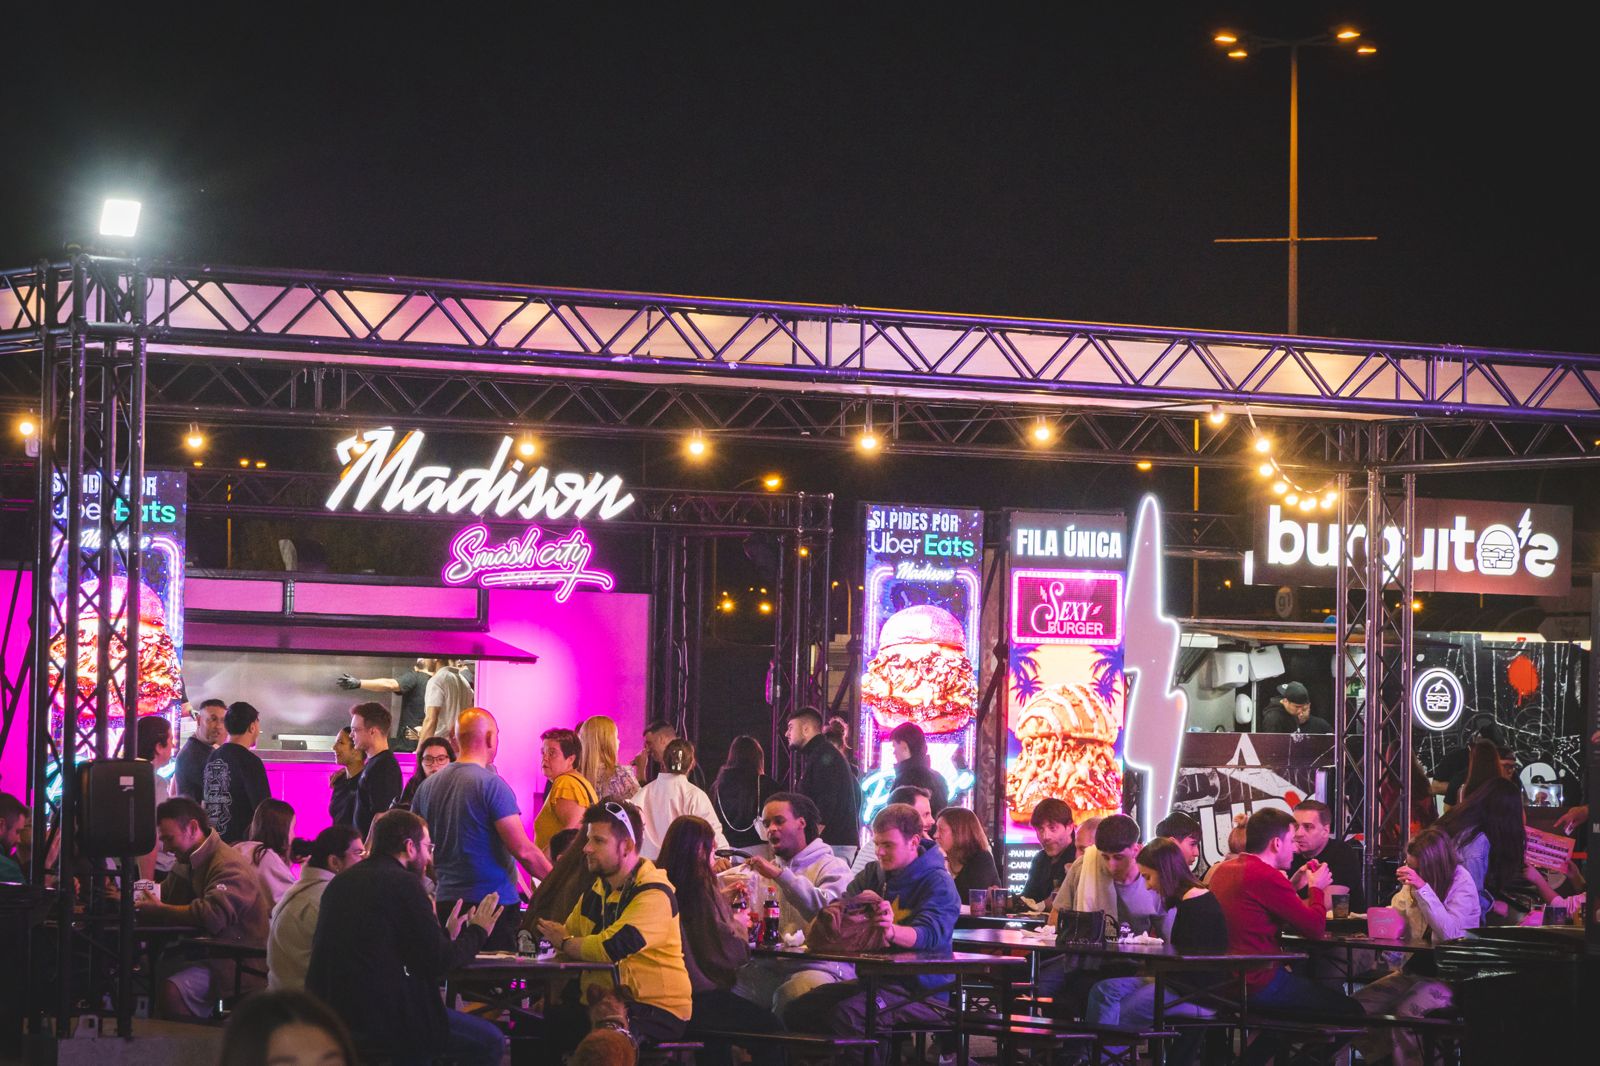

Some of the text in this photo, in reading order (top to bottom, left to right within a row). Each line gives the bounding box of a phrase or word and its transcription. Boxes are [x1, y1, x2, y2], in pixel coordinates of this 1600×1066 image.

[326, 426, 635, 520] Madison
[872, 510, 959, 532] SI PIDES POR
[445, 525, 541, 583] Smash
[871, 531, 974, 557] Uber Eats
[1017, 524, 1122, 559] FILA ÚNICA
[1047, 621, 1104, 635] BURGER
